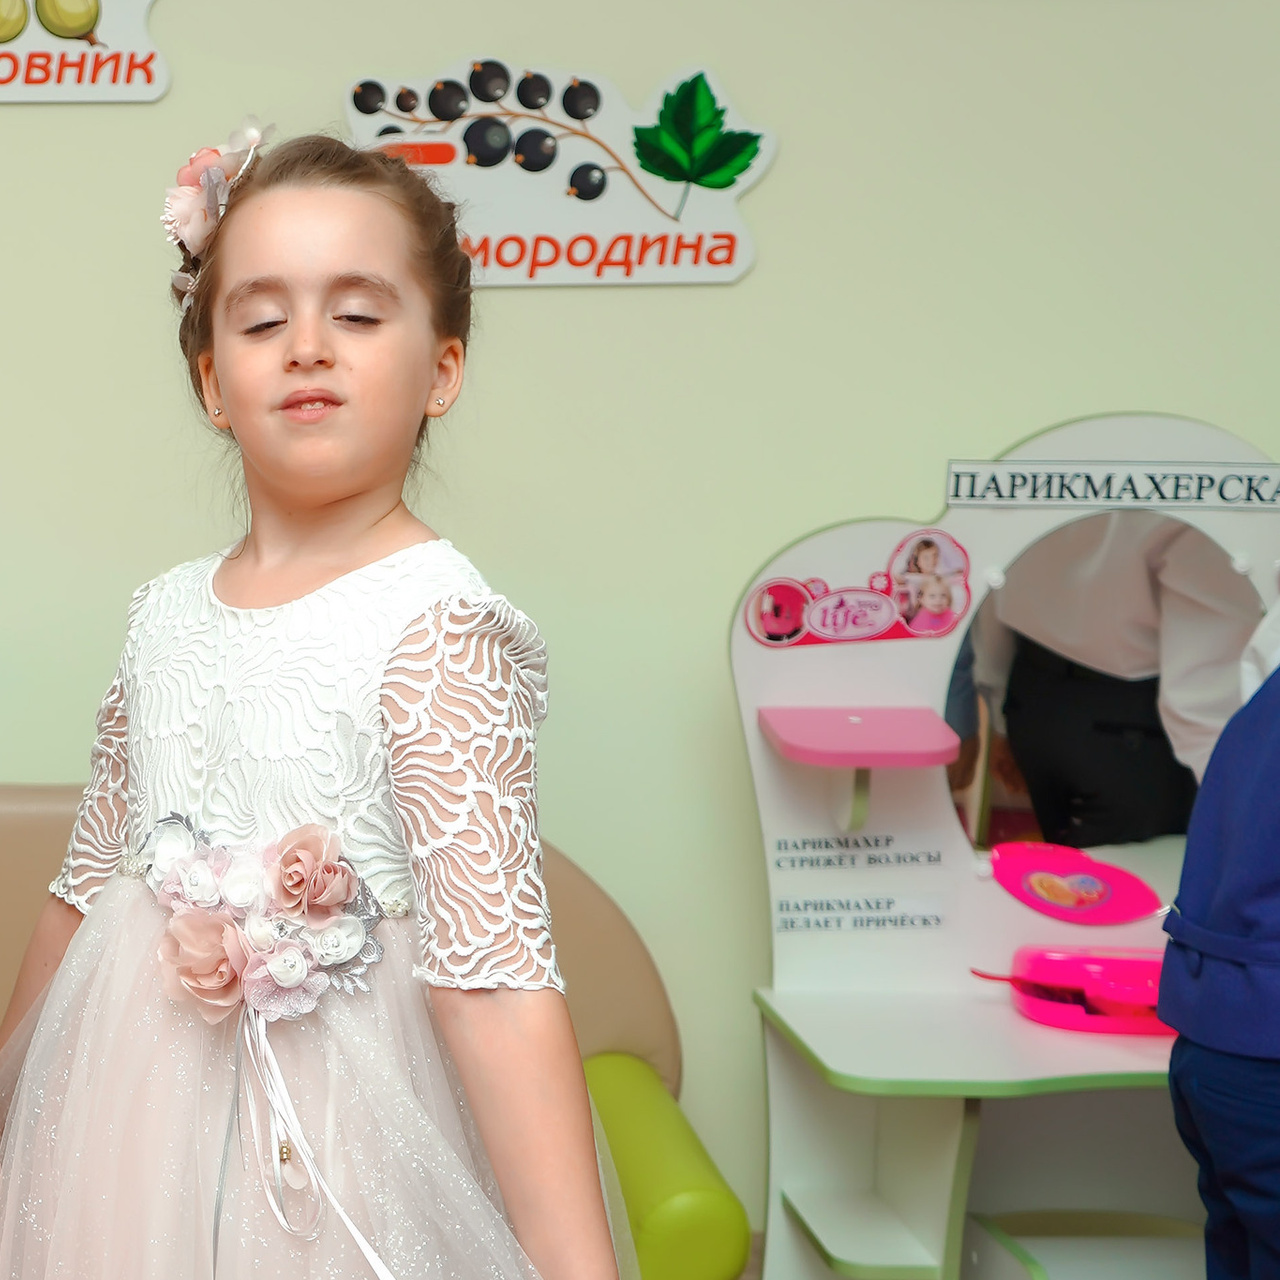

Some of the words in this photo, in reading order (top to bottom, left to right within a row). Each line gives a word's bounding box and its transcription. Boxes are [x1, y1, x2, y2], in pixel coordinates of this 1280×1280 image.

[776, 835, 894, 851] ПАРИКМАХЕР
[867, 851, 942, 866] ВОЛОСЫ
[778, 898, 895, 913] ПАРИКМАХЕР
[777, 916, 844, 931] ДЕЛАЕТ
